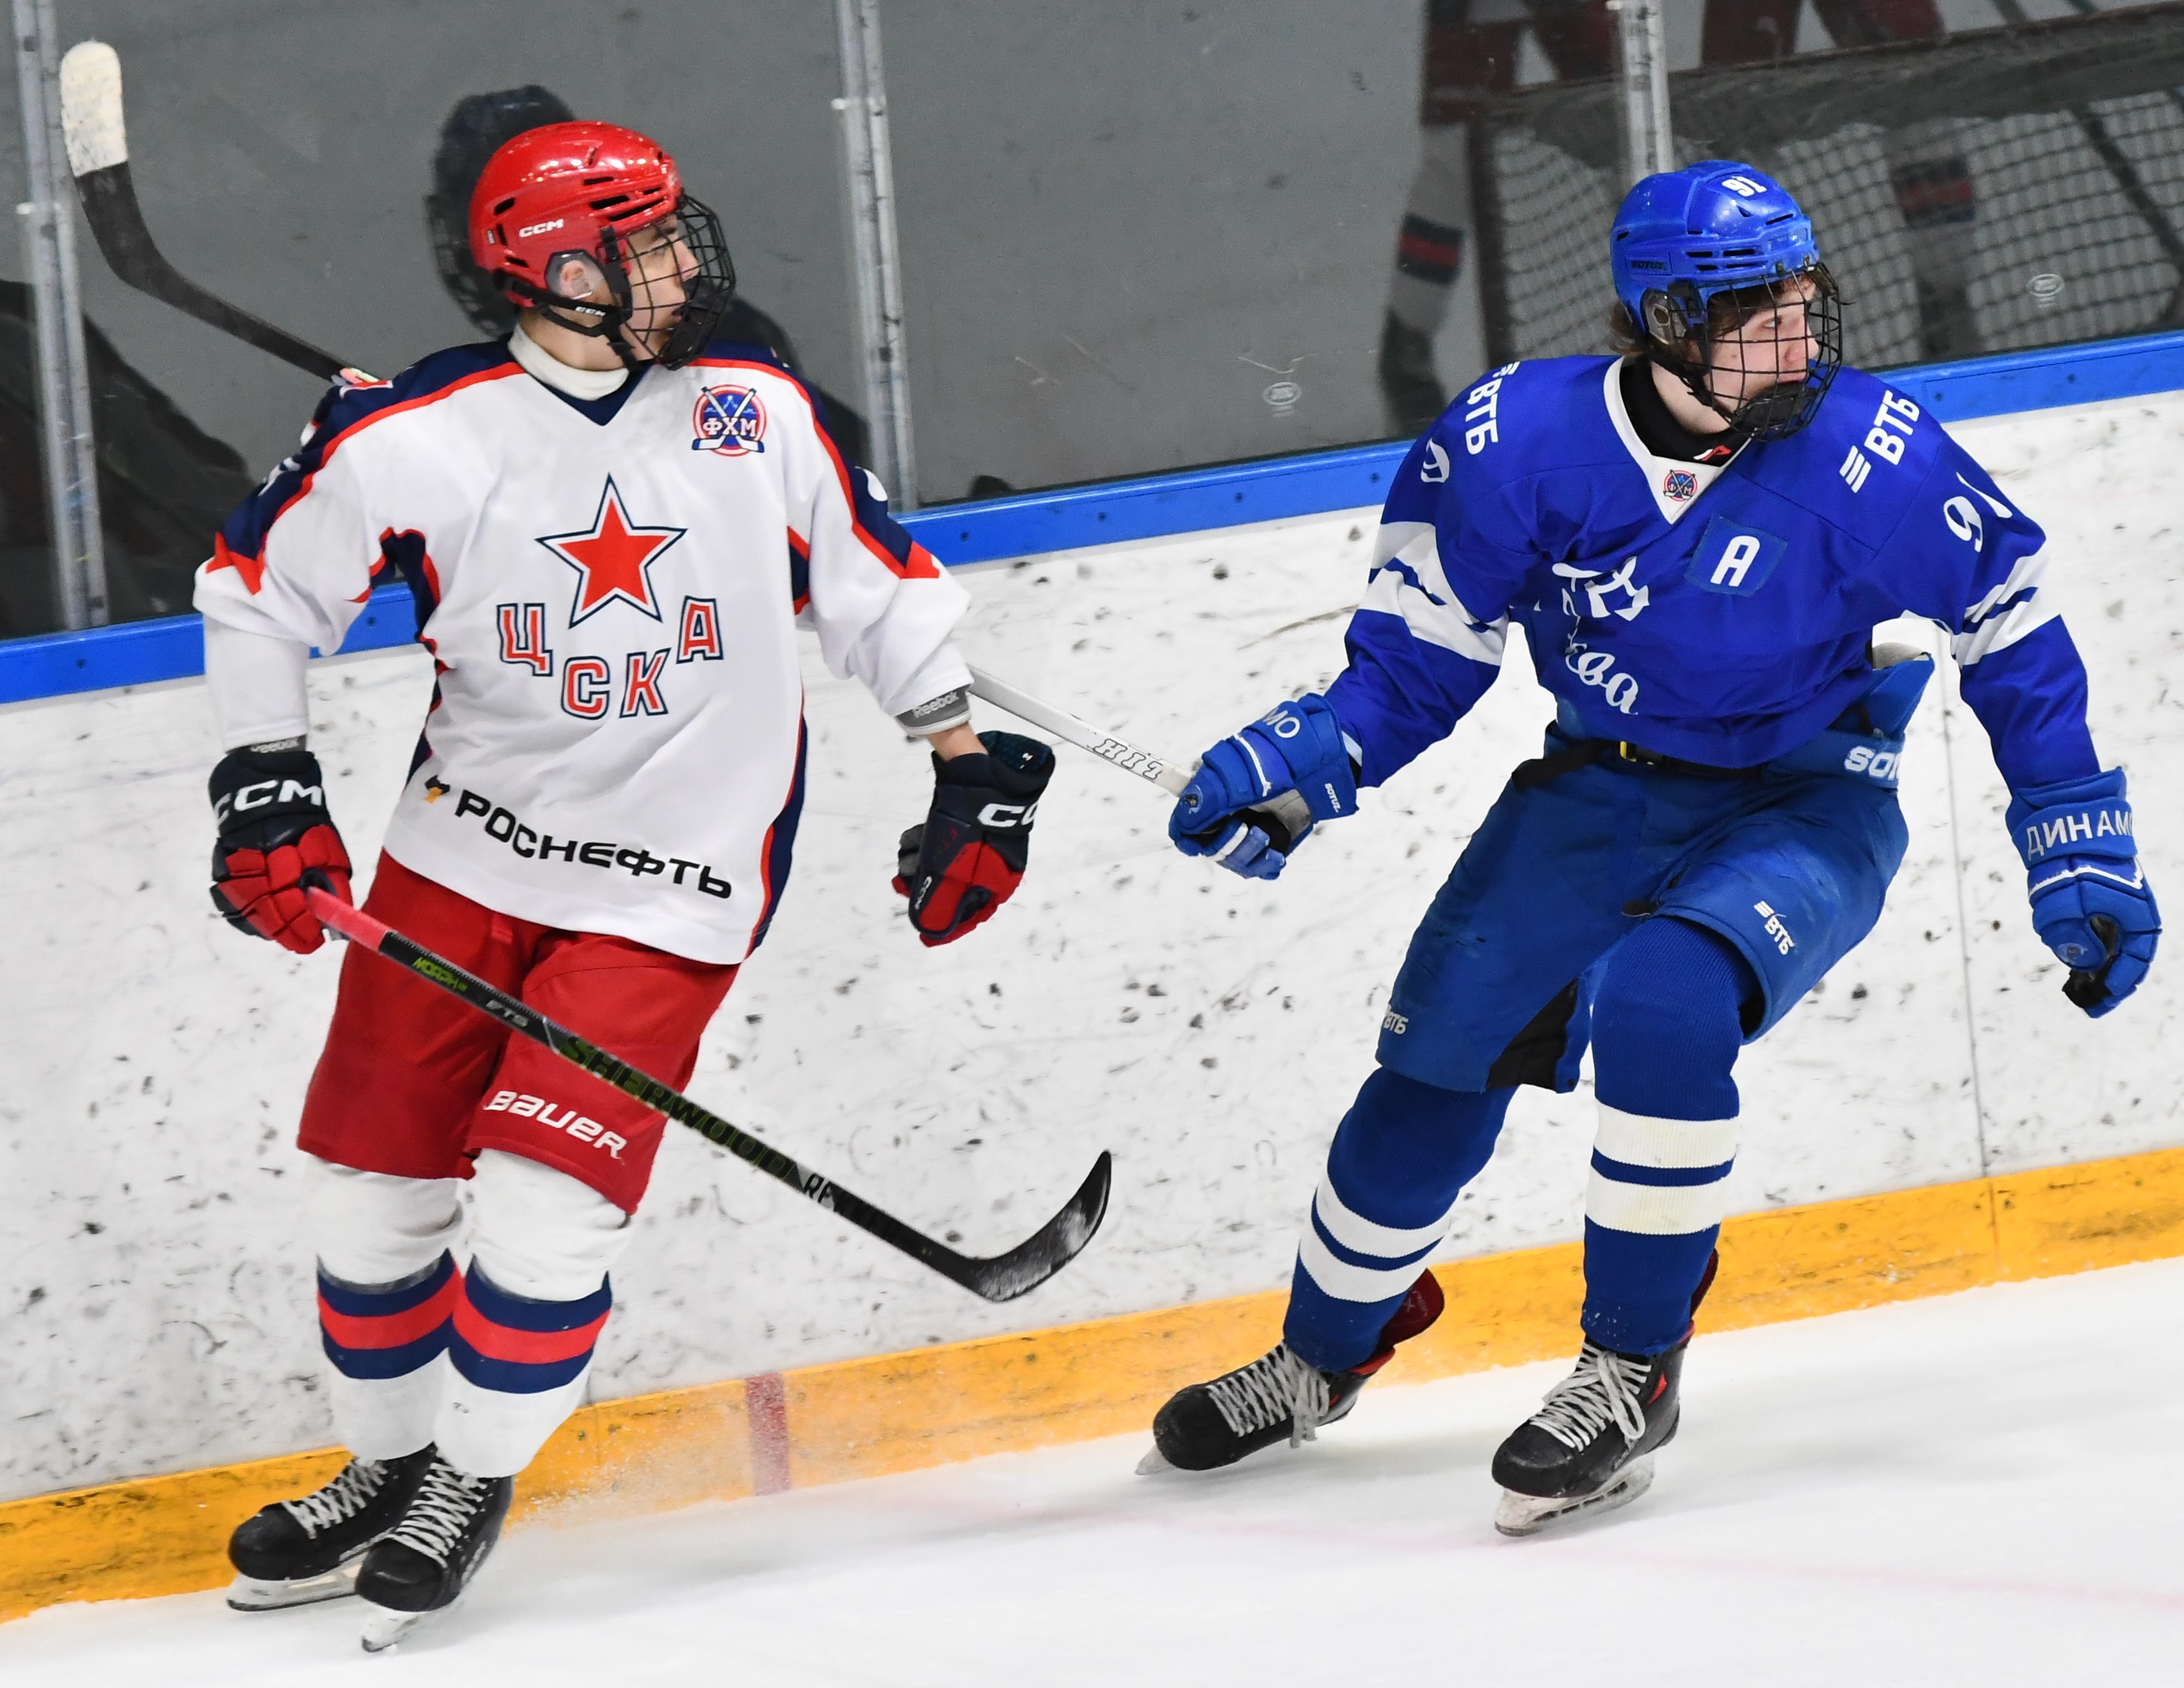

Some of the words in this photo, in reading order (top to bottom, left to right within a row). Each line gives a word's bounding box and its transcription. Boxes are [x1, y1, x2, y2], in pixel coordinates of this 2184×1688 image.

[1722, 176, 1767, 197] 91
[518, 219, 565, 238] CCM
[702, 417, 758, 437] ФХМ
[1465, 378, 1503, 455] ВТБ
[1864, 390, 1920, 465] ВТБ
[1943, 471, 2013, 552] 91
[496, 595, 724, 720] ЦСКА
[912, 691, 960, 718] Reebok
[214, 779, 322, 823] CCM
[455, 789, 732, 899] РОСНЕФТЬ
[1764, 915, 1795, 955] ВТБ
[559, 1035, 798, 1182] SHERWOOD
